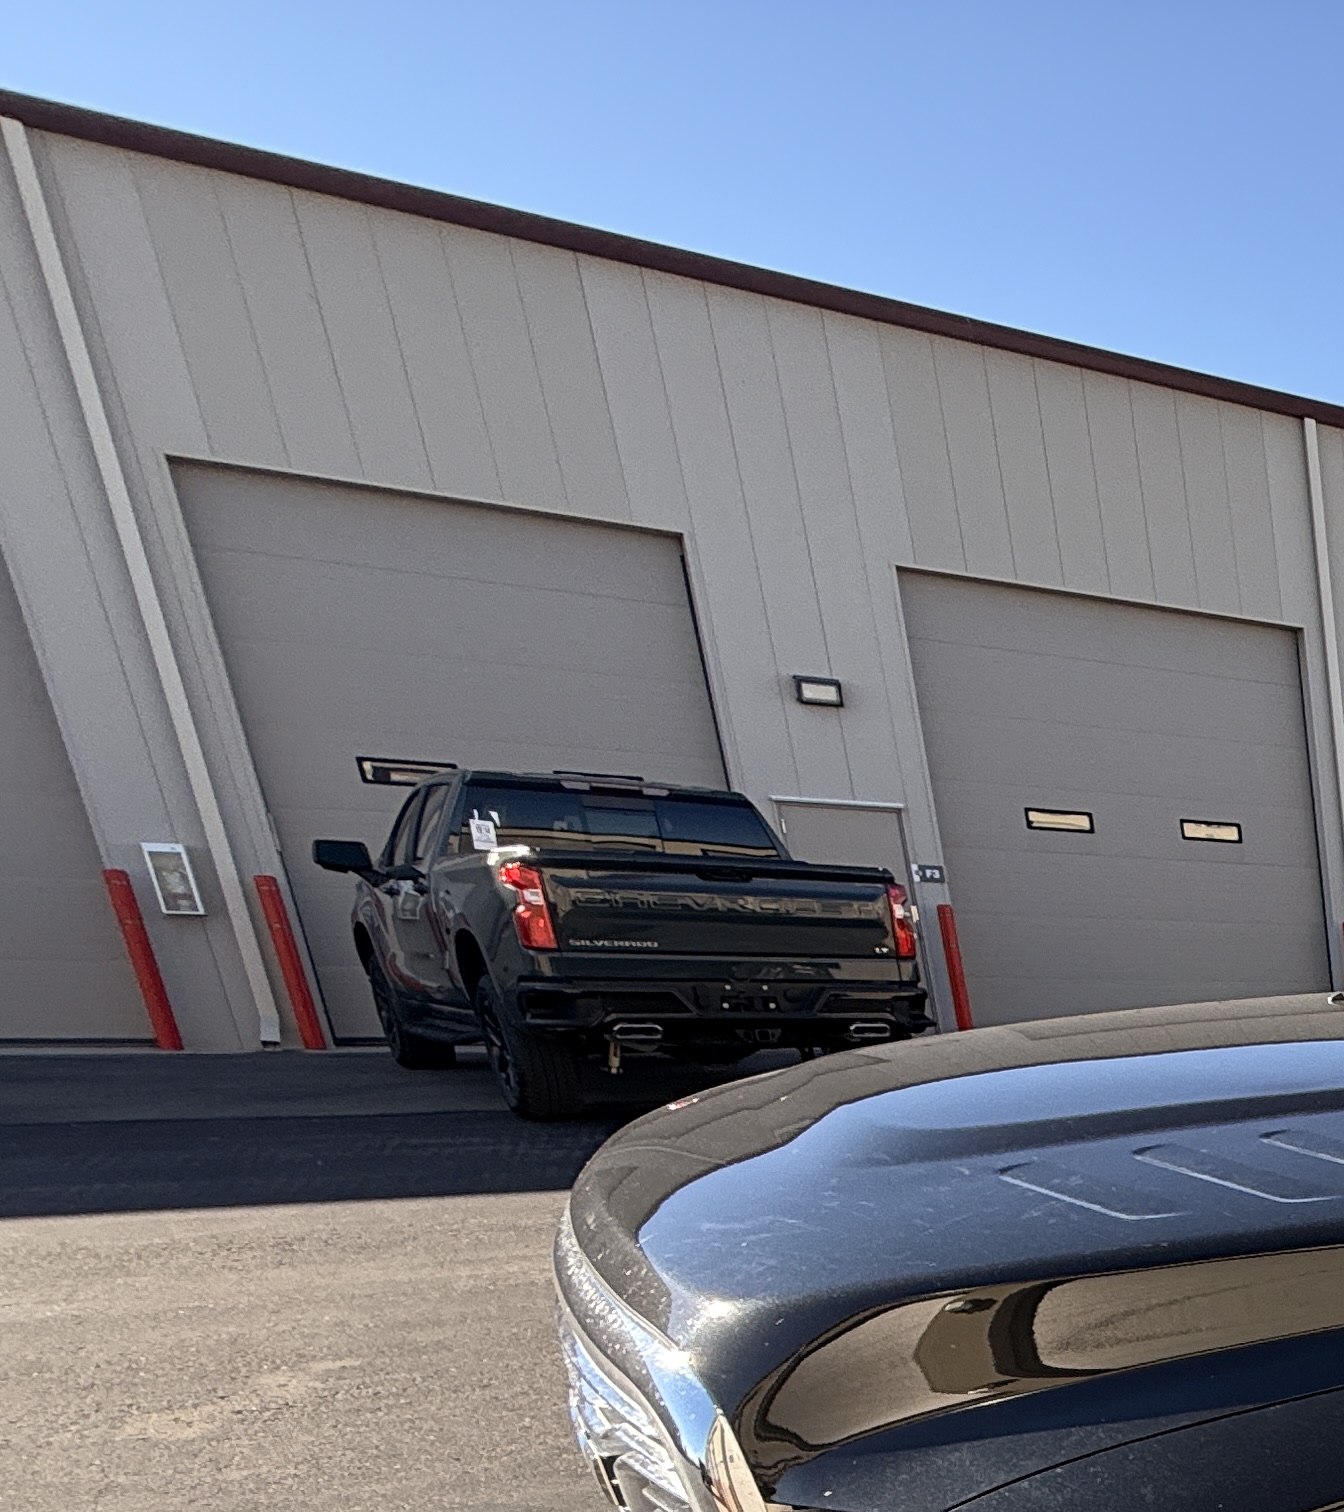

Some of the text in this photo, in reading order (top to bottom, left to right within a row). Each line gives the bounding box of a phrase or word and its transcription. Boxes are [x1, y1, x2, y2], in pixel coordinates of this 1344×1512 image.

[925, 869, 941, 879] F3
[574, 889, 882, 918] CHEVROLET
[568, 937, 659, 948] SILVERADO
